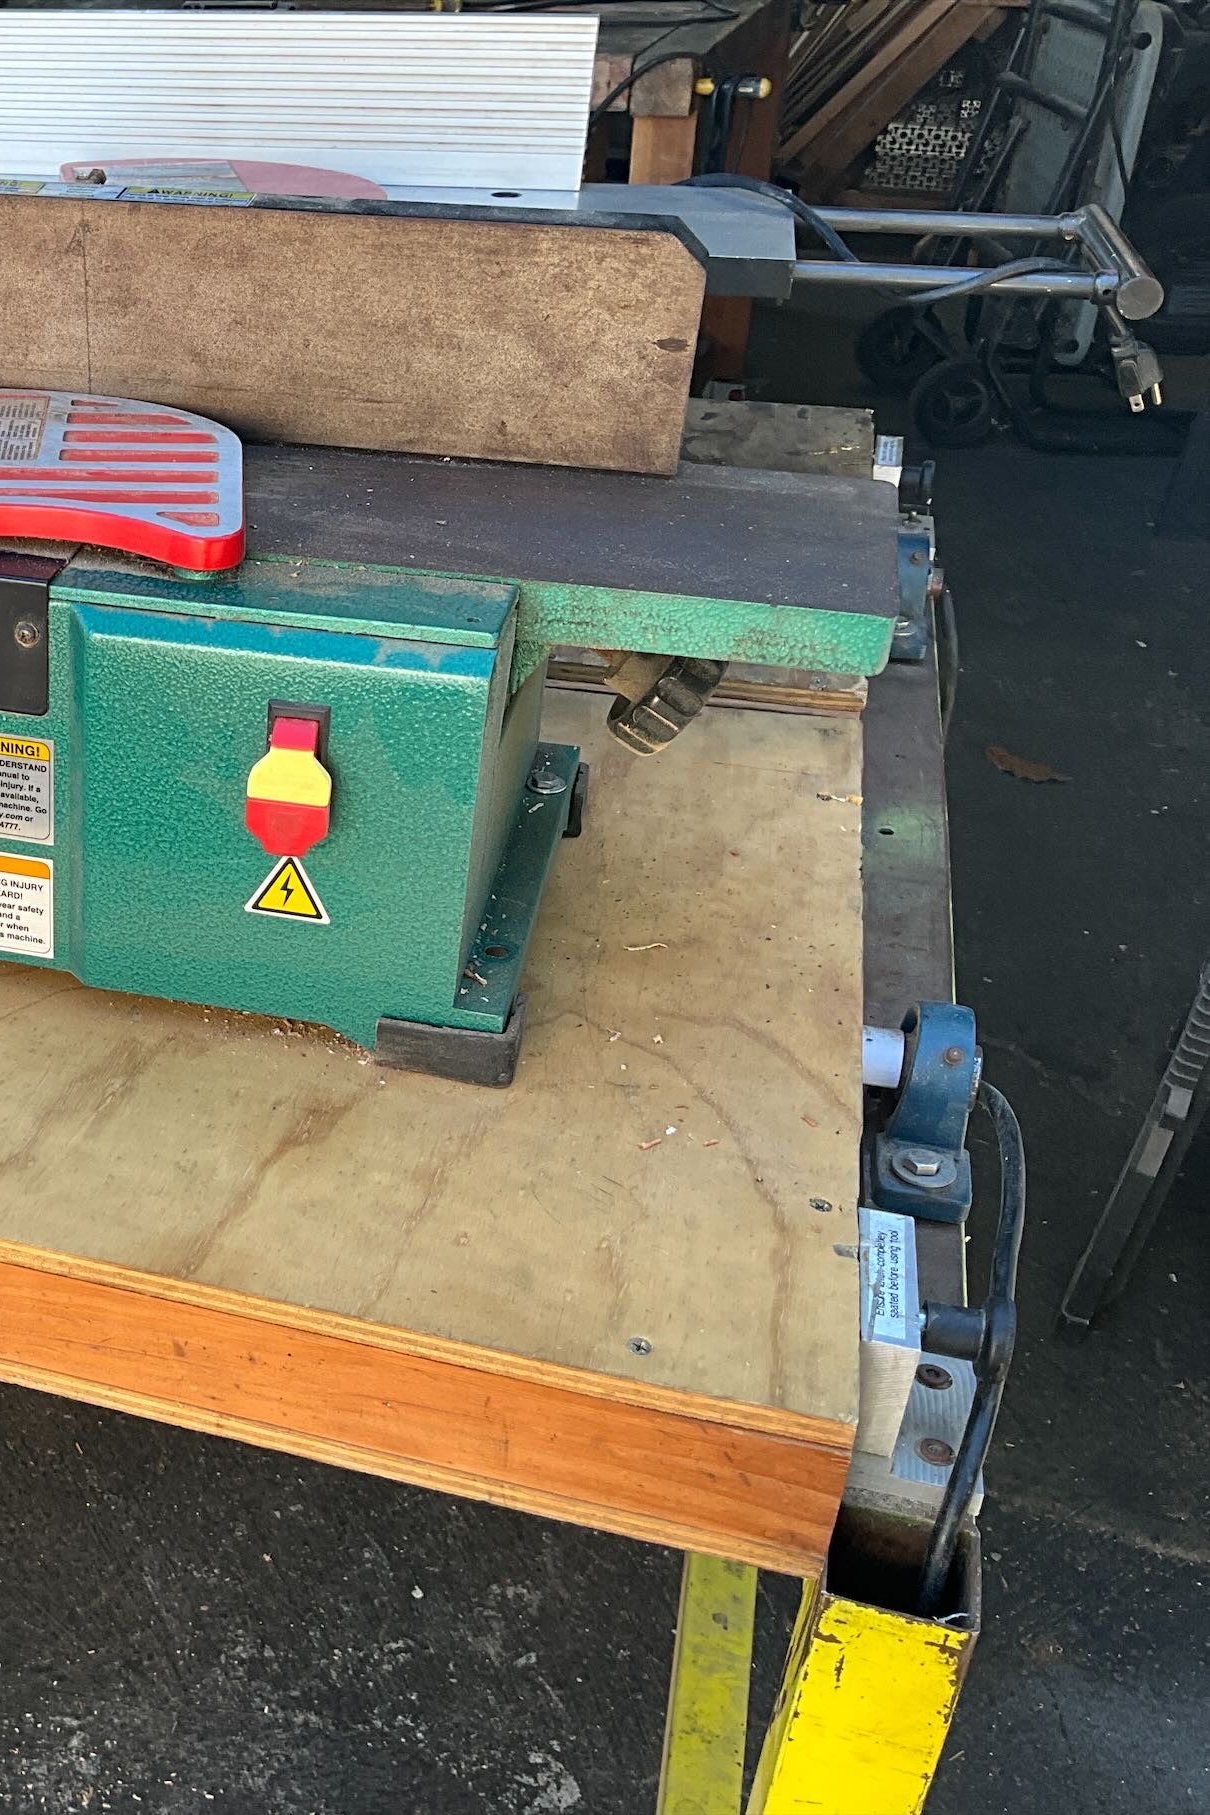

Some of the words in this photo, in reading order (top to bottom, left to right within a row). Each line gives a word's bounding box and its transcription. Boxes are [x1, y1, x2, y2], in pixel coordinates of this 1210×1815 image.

[21, 773, 30, 781] to
[0, 780, 26, 792] injury.
[28, 784, 34, 792] If
[0, 791, 39, 804] available,
[35, 806, 47, 814] Go
[10, 880, 43, 892] INJURY
[18, 904, 44, 916] safety
[5, 922, 29, 932] when
[6, 932, 45, 945] machine.
[888, 1229, 899, 1244] tool
[890, 1245, 901, 1264] using
[888, 1266, 899, 1291] before
[889, 1292, 899, 1319] seated
